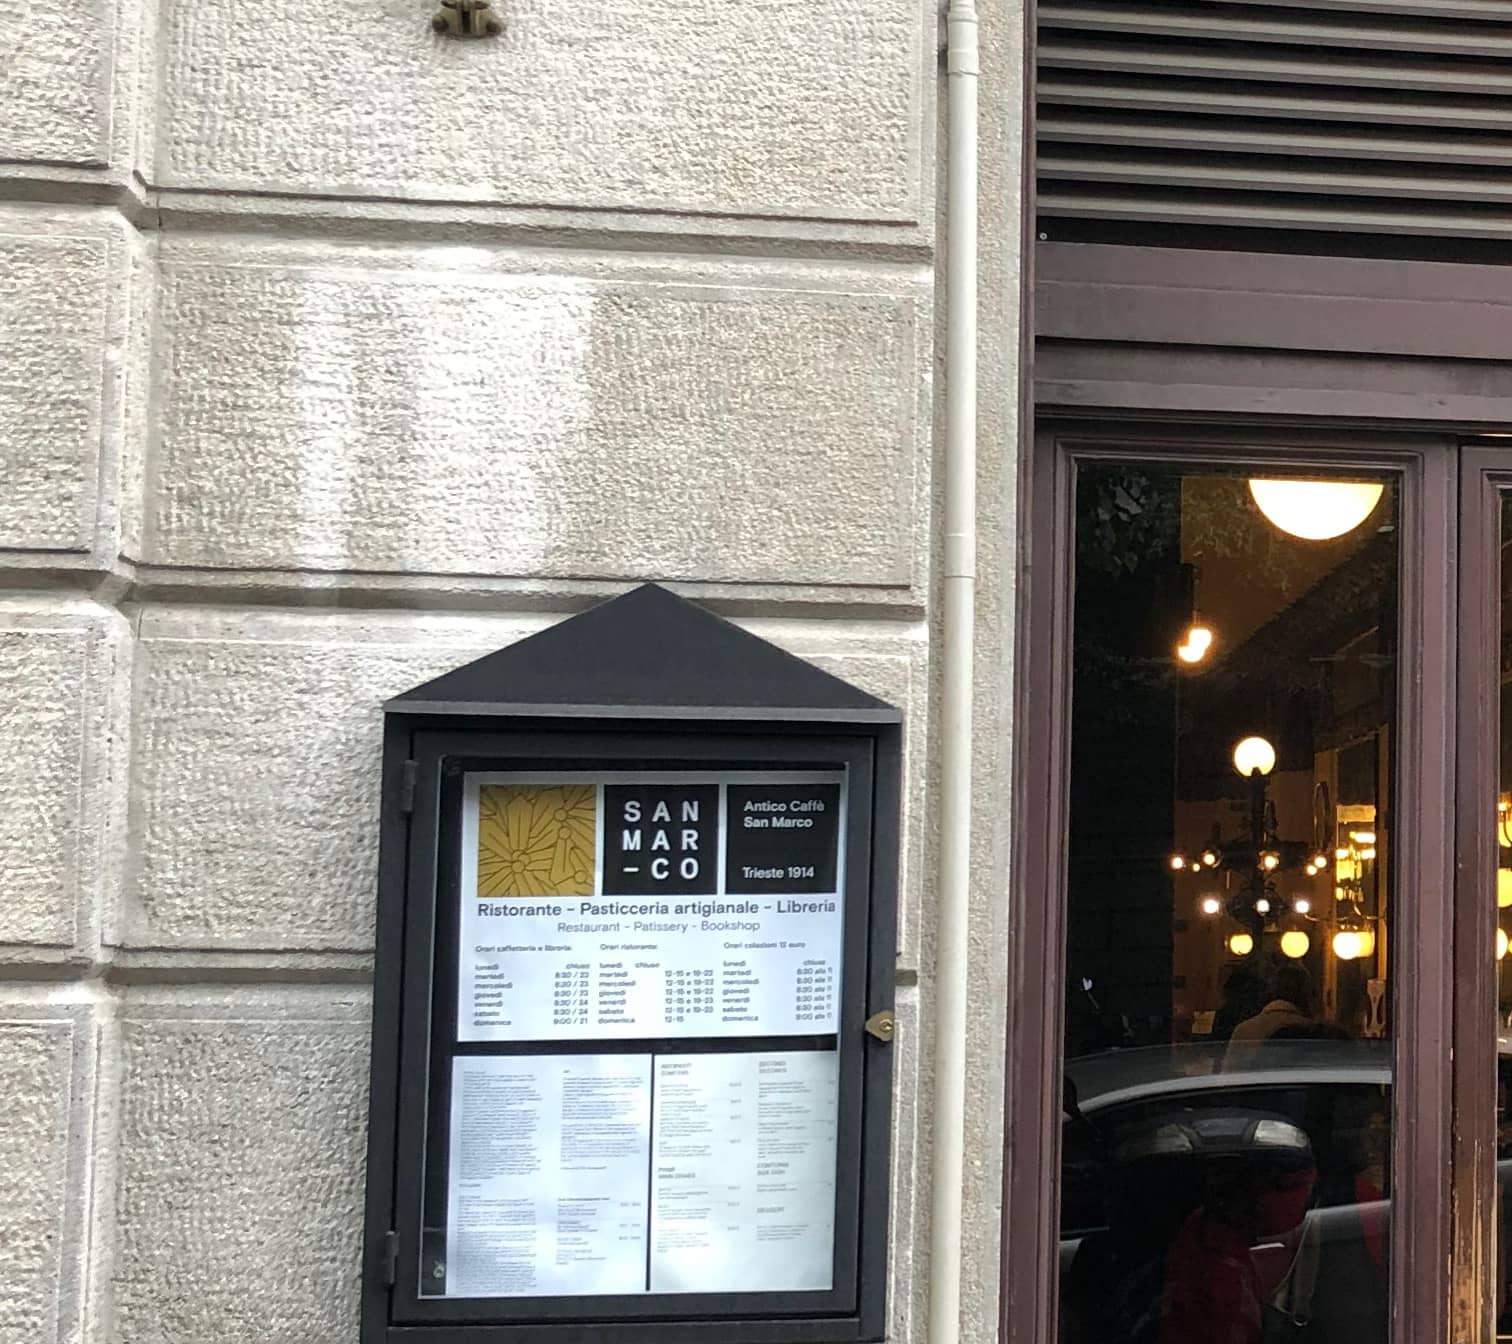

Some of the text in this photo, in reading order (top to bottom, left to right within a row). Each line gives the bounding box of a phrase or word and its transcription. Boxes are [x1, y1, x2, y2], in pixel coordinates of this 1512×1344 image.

[623, 800, 700, 823] SAN
[743, 800, 825, 813] Antico Caffè
[743, 816, 813, 828] San Marco
[621, 829, 700, 852] MAR
[742, 866, 815, 879] Trieste 1914
[477, 902, 562, 917] Ristorante
[580, 901, 669, 915] Pasticceria
[675, 900, 759, 918] artigianale
[777, 900, 836, 914] Libreria
[557, 921, 620, 933] Restaurant
[633, 921, 689, 934] Patissery
[701, 920, 761, 933] Bookshop
